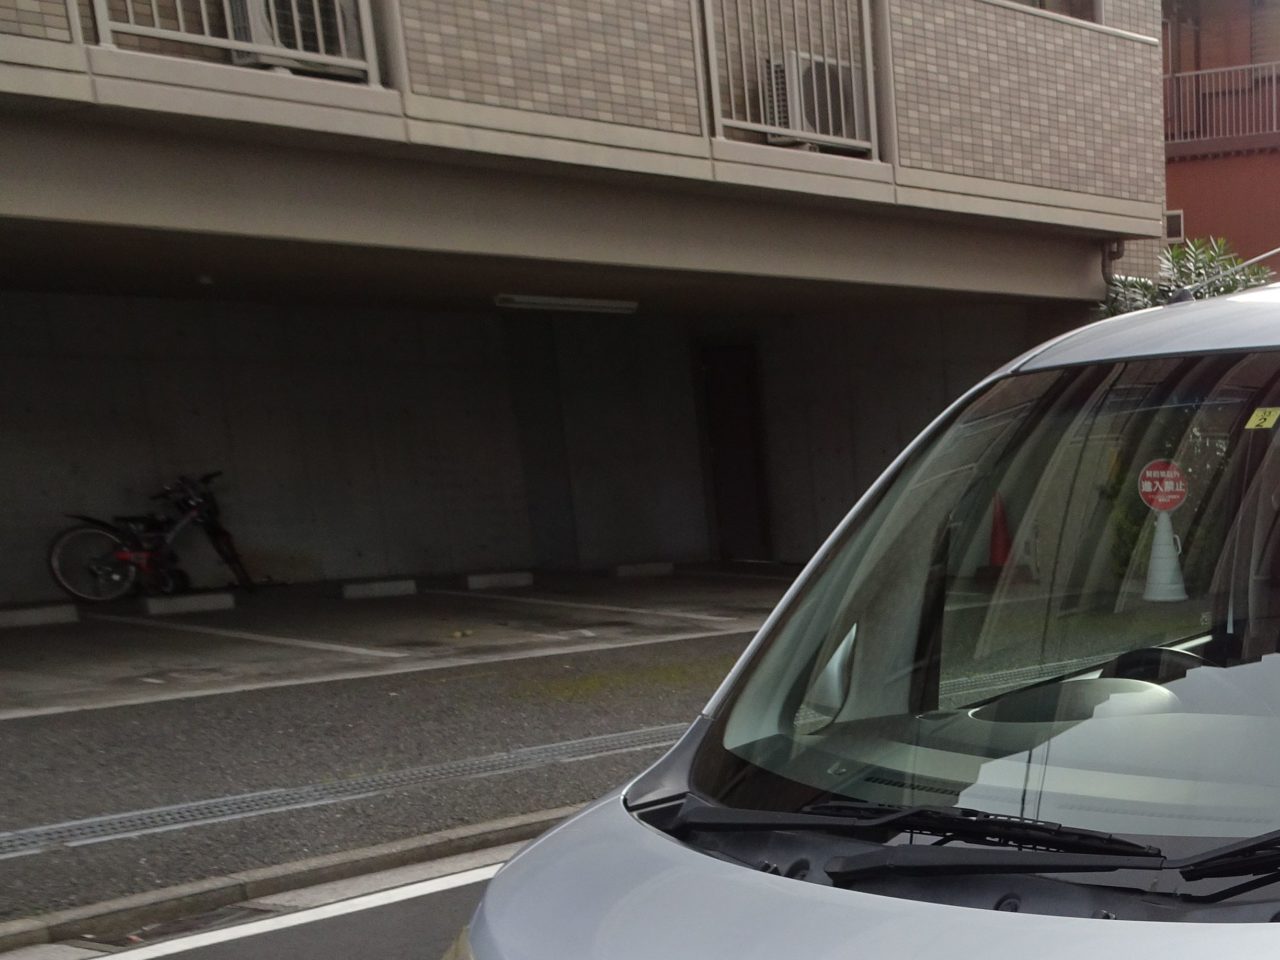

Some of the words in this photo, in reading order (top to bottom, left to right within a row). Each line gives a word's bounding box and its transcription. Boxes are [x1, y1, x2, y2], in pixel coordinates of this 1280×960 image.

[1255, 417, 1267, 427] 2
[1141, 479, 1186, 493] 進入禁止
